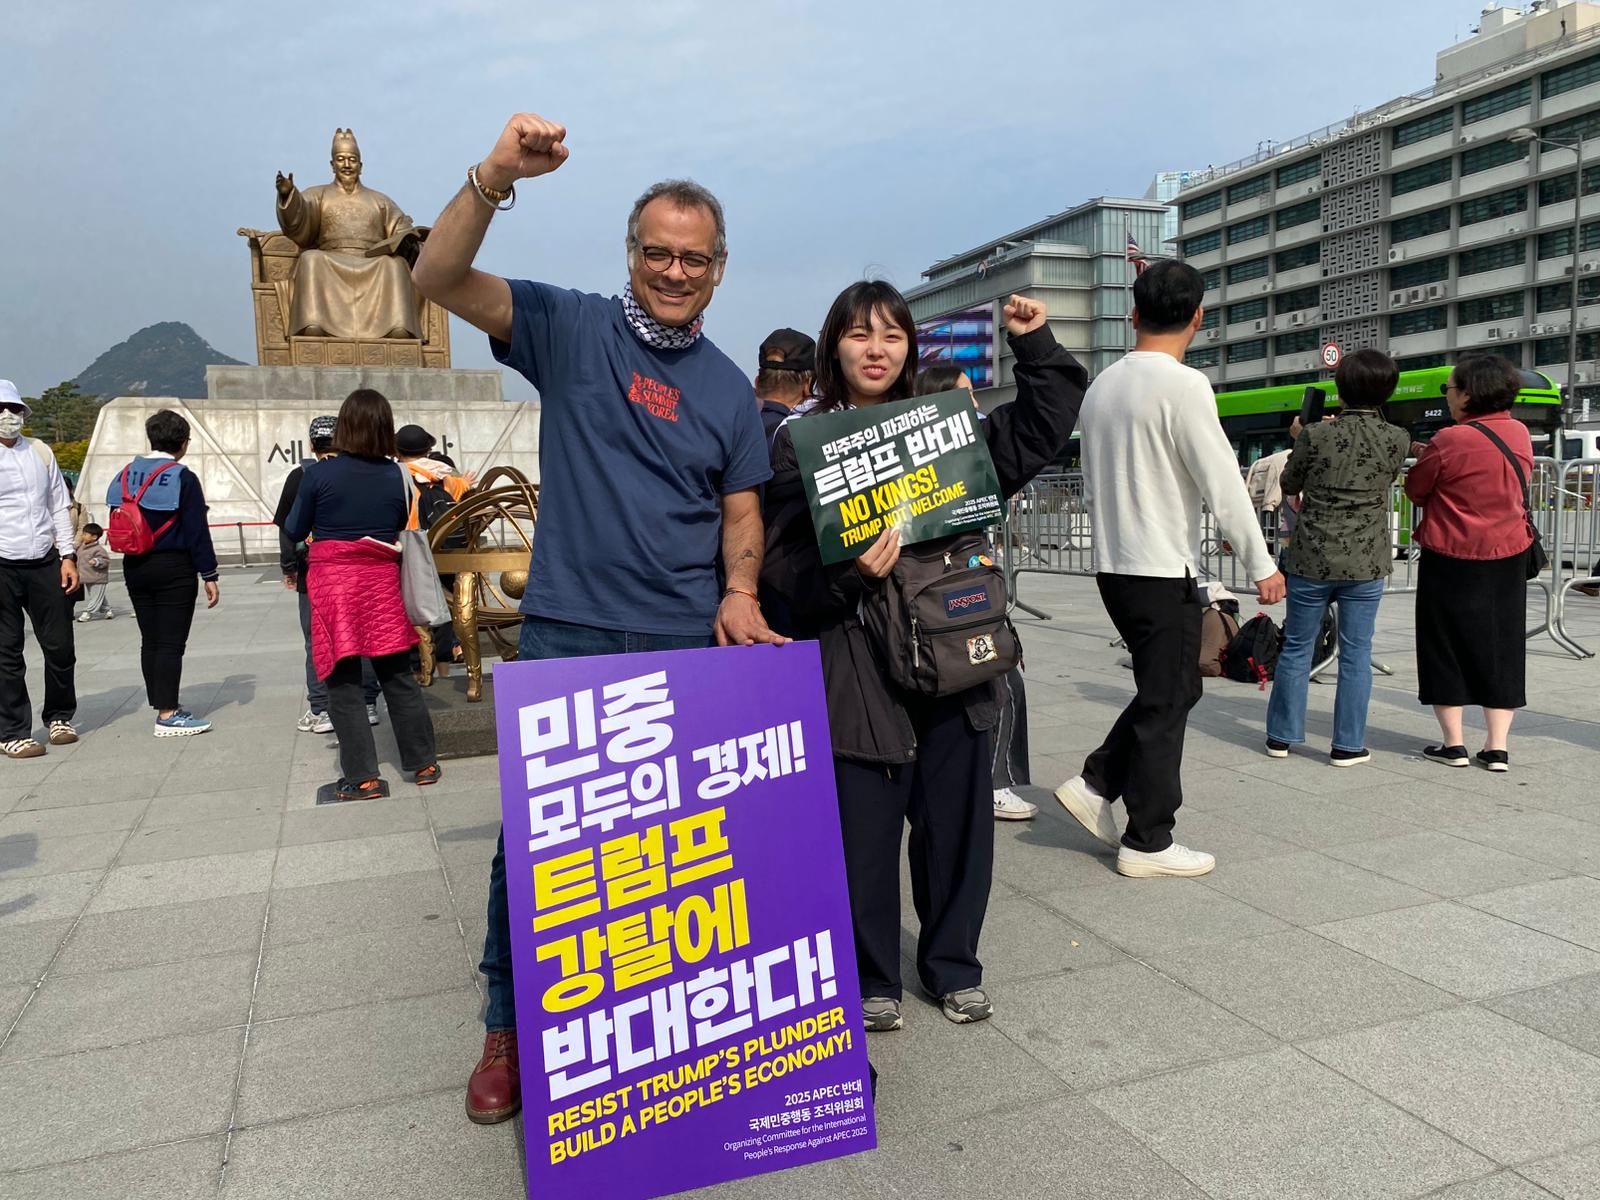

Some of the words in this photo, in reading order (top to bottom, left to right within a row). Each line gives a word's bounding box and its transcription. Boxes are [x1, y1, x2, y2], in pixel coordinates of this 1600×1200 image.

[1326, 350, 1337, 362] 50
[643, 390, 677, 409] SUMMIT
[1424, 409, 1442, 417] 5422
[813, 441, 905, 506] 트럼프
[904, 410, 976, 467] 반대!
[821, 424, 881, 462] 민주주의
[880, 404, 940, 439] 파괴하는
[839, 493, 871, 528] NO
[871, 463, 939, 514] KINGS!
[839, 517, 882, 548] TRUMP
[883, 506, 907, 529] NOT
[909, 480, 967, 517] WELCOME
[948, 592, 987, 611] JANSPORT
[518, 670, 675, 790] 민중
[528, 755, 681, 852] 모두의
[692, 720, 807, 800] 경제!
[532, 806, 734, 933] 트럼프
[536, 878, 751, 1013] 강탈에
[541, 929, 837, 1101] 반대한다!
[548, 1085, 632, 1137] RESIST
[636, 1046, 741, 1101] TRUMP'S
[744, 1006, 846, 1062] PLUNDER
[550, 1121, 616, 1165] BUILD
[620, 1114, 637, 1138] A
[639, 1073, 742, 1130] PEOPLE'S
[744, 1029, 852, 1089] ECONOMY!
[784, 1091, 811, 1106] 2025
[812, 1085, 841, 1101] APEC
[841, 1079, 862, 1095] 반대
[723, 1136, 762, 1152] Organizing
[762, 1128, 801, 1143] Committee
[801, 1126, 812, 1134] for
[811, 1123, 824, 1132] the
[824, 1113, 867, 1130] International
[743, 1147, 774, 1160] People's
[773, 1141, 807, 1154] Response
[807, 1135, 833, 1148] Against
[832, 1130, 851, 1141] APEC
[851, 1126, 868, 1138] 2025
[749, 1107, 812, 1132] 국제민중행동
[814, 1096, 865, 1118] 조직위원회
